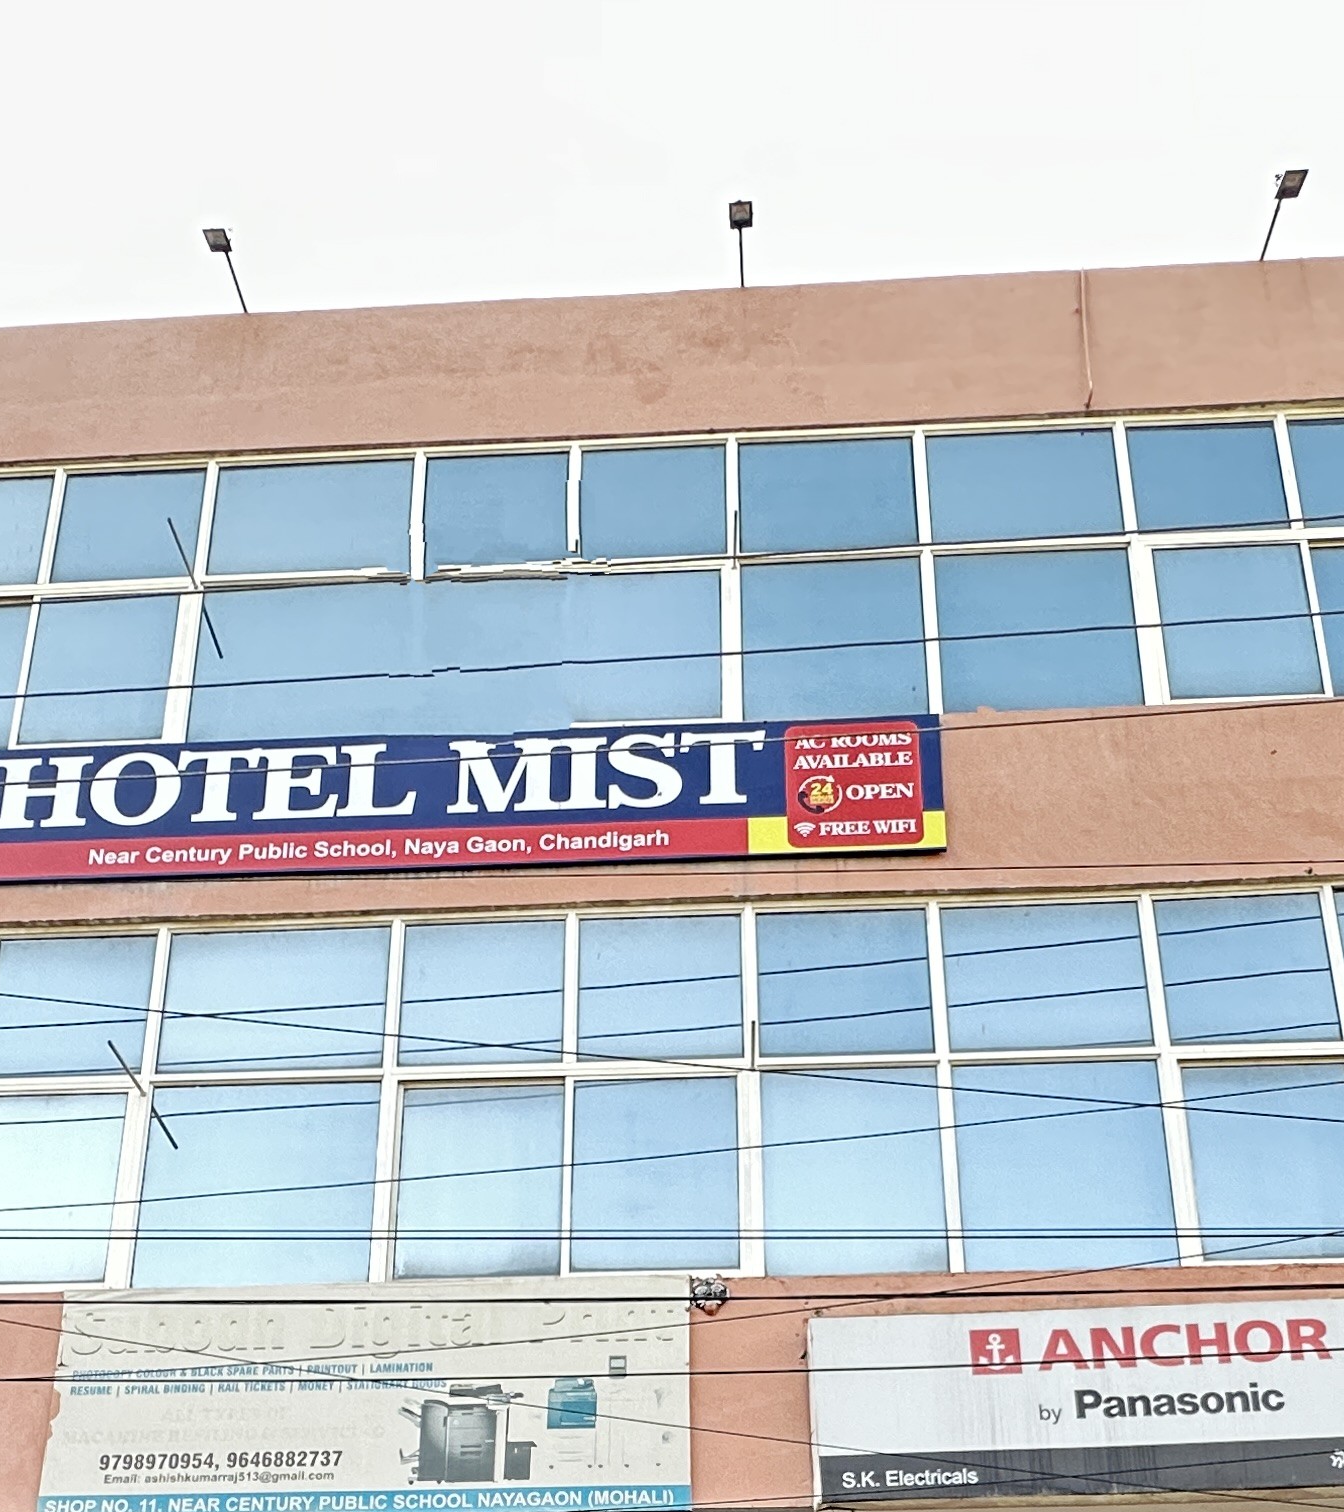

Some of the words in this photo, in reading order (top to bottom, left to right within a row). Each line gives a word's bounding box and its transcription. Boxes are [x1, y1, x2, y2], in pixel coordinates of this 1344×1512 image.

[830, 732, 913, 749] ROOMS
[793, 751, 914, 770] AVAILABLE
[446, 729, 766, 814] MIST
[810, 782, 834, 795] 24
[845, 782, 915, 800] OPEN
[818, 820, 871, 836] FREE
[872, 818, 917, 834] WIFI
[87, 846, 140, 866] Near
[144, 843, 232, 866] Century
[238, 841, 308, 861] Public
[313, 838, 398, 860] School,
[404, 838, 460, 859] Naya
[466, 835, 533, 855] Gaon,
[538, 829, 671, 852] Chandigarh
[1038, 1318, 1333, 1372] ANCHOR
[190, 1366, 223, 1377] BLACK
[227, 1365, 258, 1376] SPARE
[262, 1364, 294, 1375] PARTS
[307, 1363, 359, 1374] PRINTOUT
[369, 1362, 434, 1373] LAMINATION
[70, 1385, 113, 1396] RESUME
[124, 1384, 161, 1395] SPIRAL
[163, 1383, 206, 1394] BINDING
[218, 1383, 240, 1393] RAIL
[243, 1382, 286, 1393] TICKETS
[297, 1381, 335, 1392] MONEY
[1038, 1403, 1062, 1424] by
[1073, 1382, 1286, 1420] Panasonic
[99, 1453, 220, 1472] 9798970954,
[226, 1450, 343, 1468] 9646882737
[104, 1472, 142, 1485] Email:
[841, 1471, 880, 1489] S.K.
[885, 1467, 979, 1488] Electricals
[168, 1498, 220, 1512] NEAR
[225, 1496, 315, 1512] CENTURY
[318, 1494, 388, 1510] PUBLIC
[392, 1492, 473, 1509] SCHOOL
[477, 1490, 583, 1508] NAYAGAON
[588, 1489, 674, 1507] (MOHALI)
